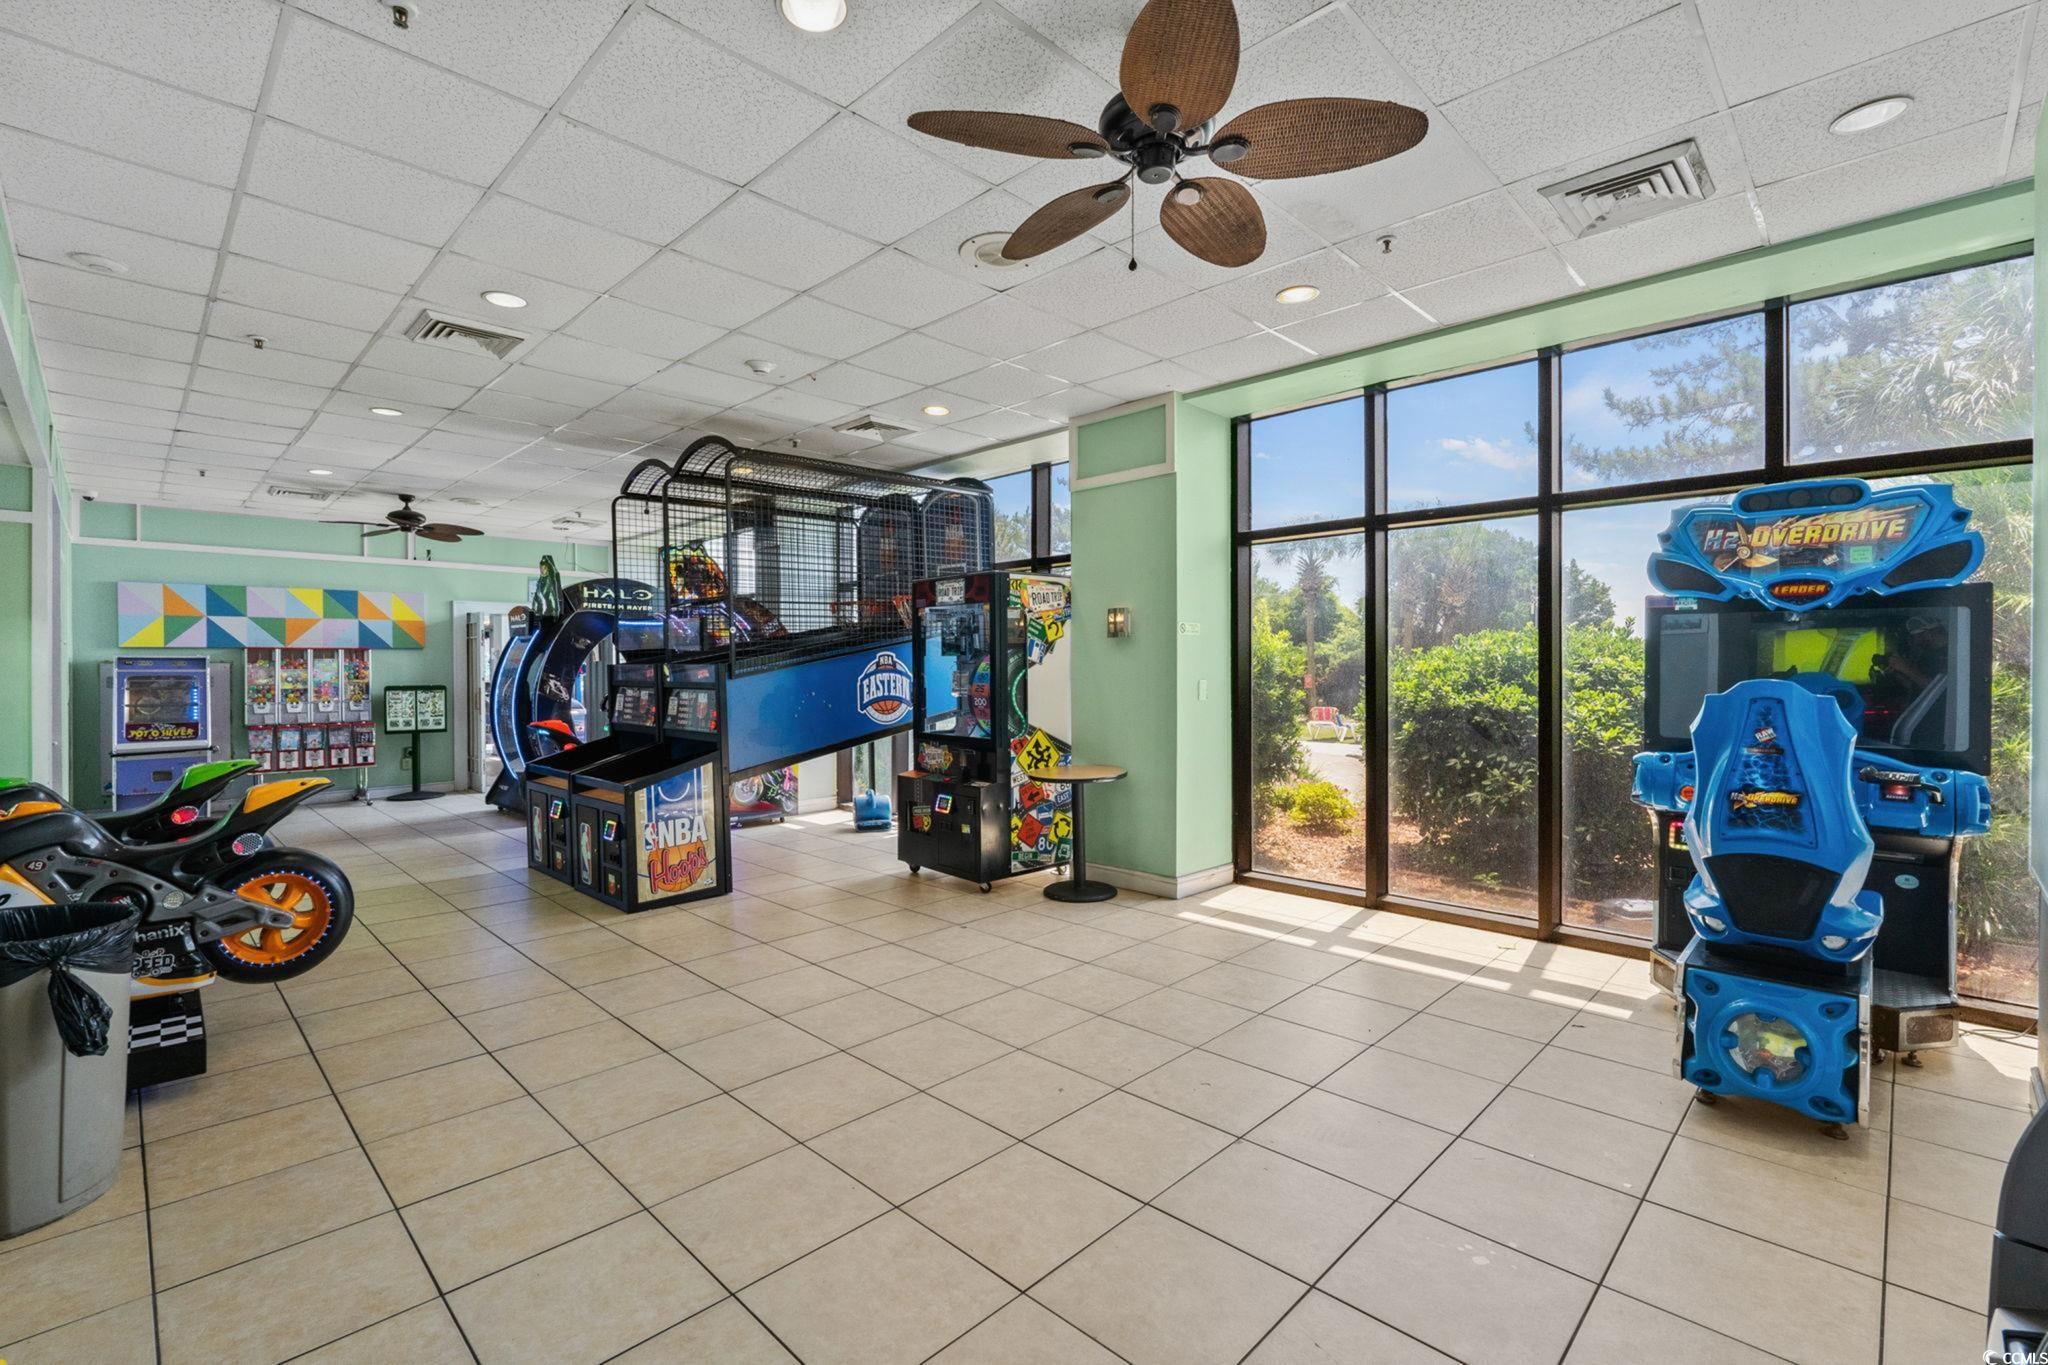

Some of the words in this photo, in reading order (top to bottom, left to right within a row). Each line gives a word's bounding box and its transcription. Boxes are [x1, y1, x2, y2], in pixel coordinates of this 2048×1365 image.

[583, 586, 653, 600] HALO
[1773, 584, 1825, 595] LEADER
[1031, 592, 1050, 605] ROAD
[1051, 591, 1063, 602] TRIP
[879, 655, 893, 665] NBA
[863, 672, 910, 703] EASTERN
[974, 697, 987, 706] 200
[1057, 791, 1070, 803] EAST
[657, 815, 709, 849] NBA
[1038, 836, 1054, 851] 80
[27, 861, 43, 871] 49
[650, 847, 709, 894] Hoops
[134, 924, 185, 943] hanix
